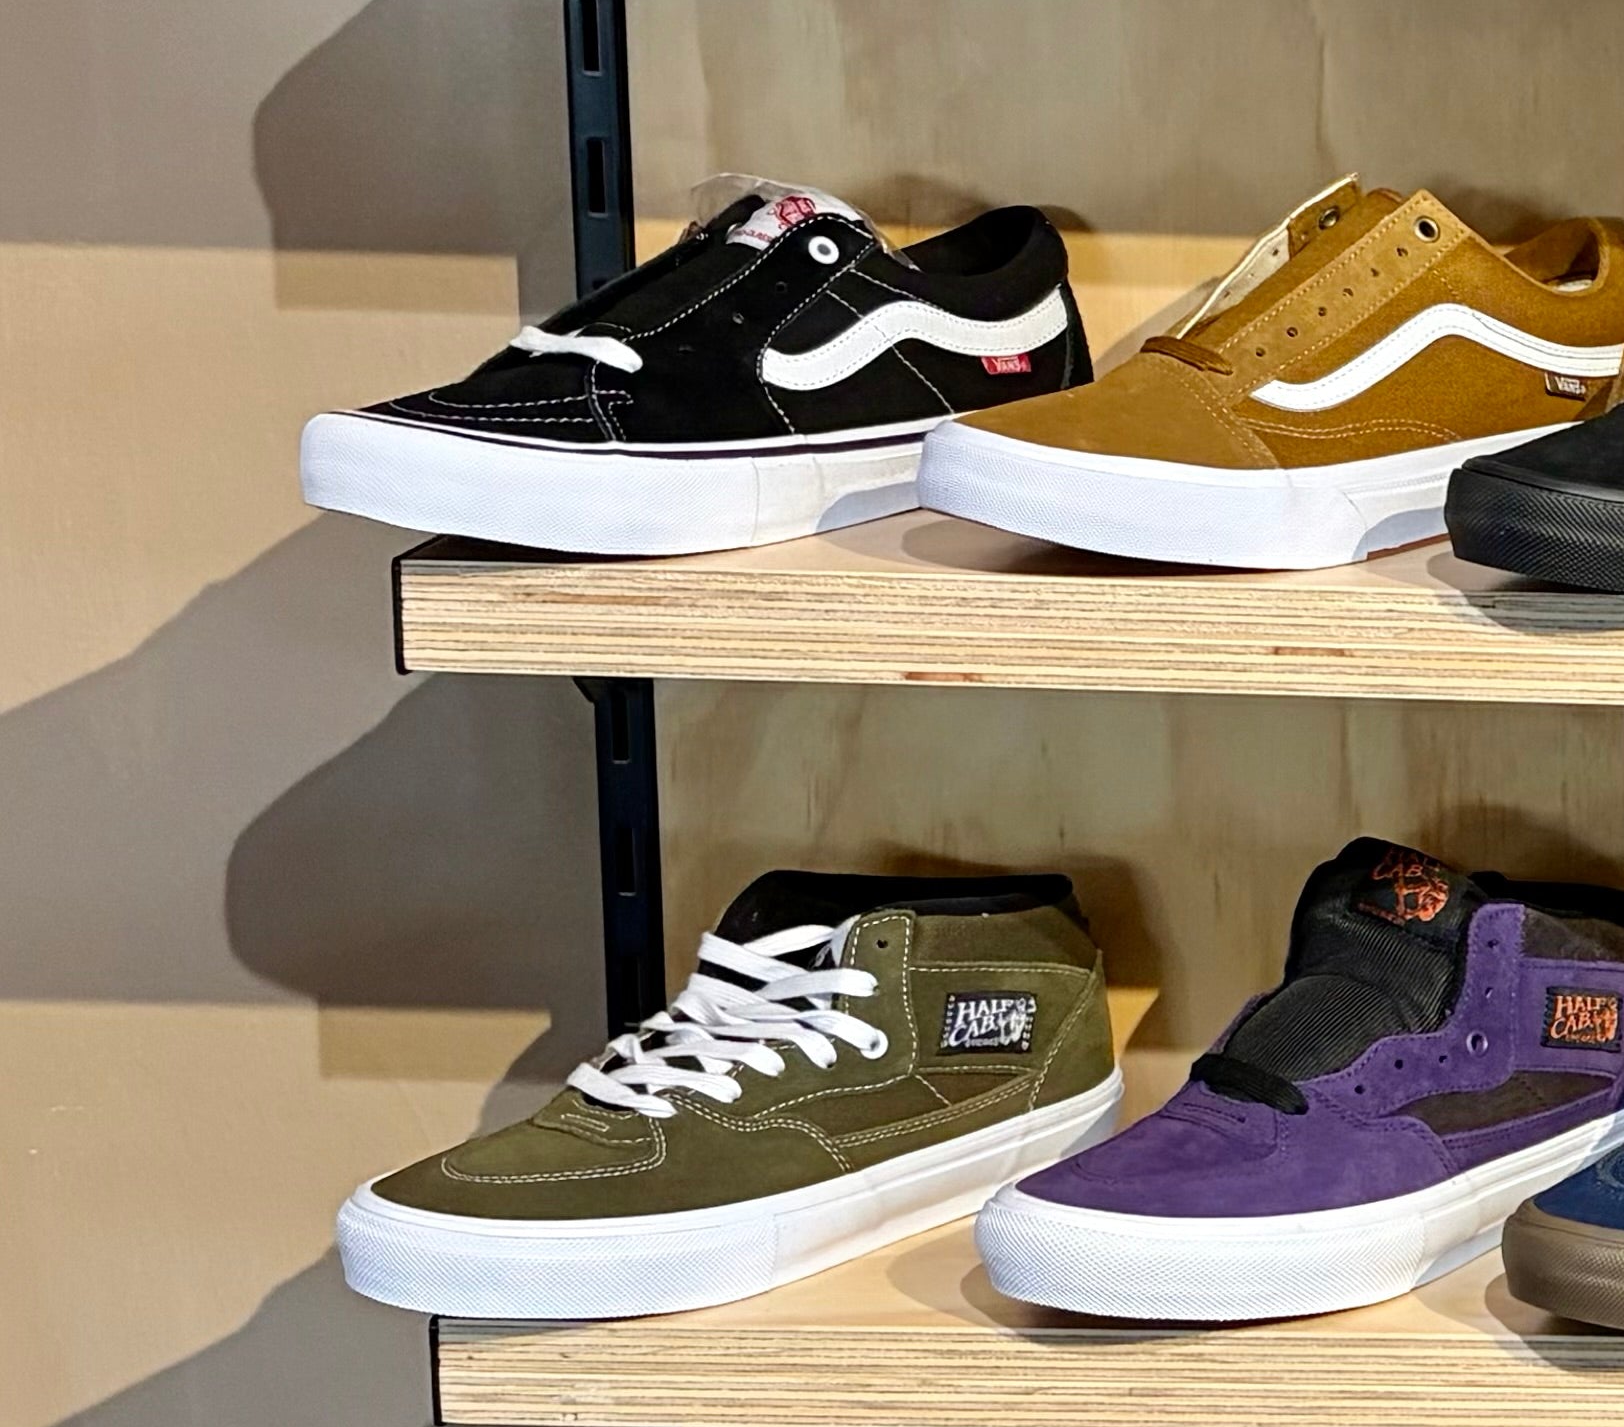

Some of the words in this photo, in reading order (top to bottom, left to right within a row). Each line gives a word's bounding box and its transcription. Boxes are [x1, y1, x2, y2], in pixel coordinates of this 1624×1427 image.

[957, 999, 1017, 1021] HALF
[1554, 996, 1605, 1020] HALF
[949, 1015, 998, 1047] CAB
[1550, 1012, 1593, 1039] CAB
